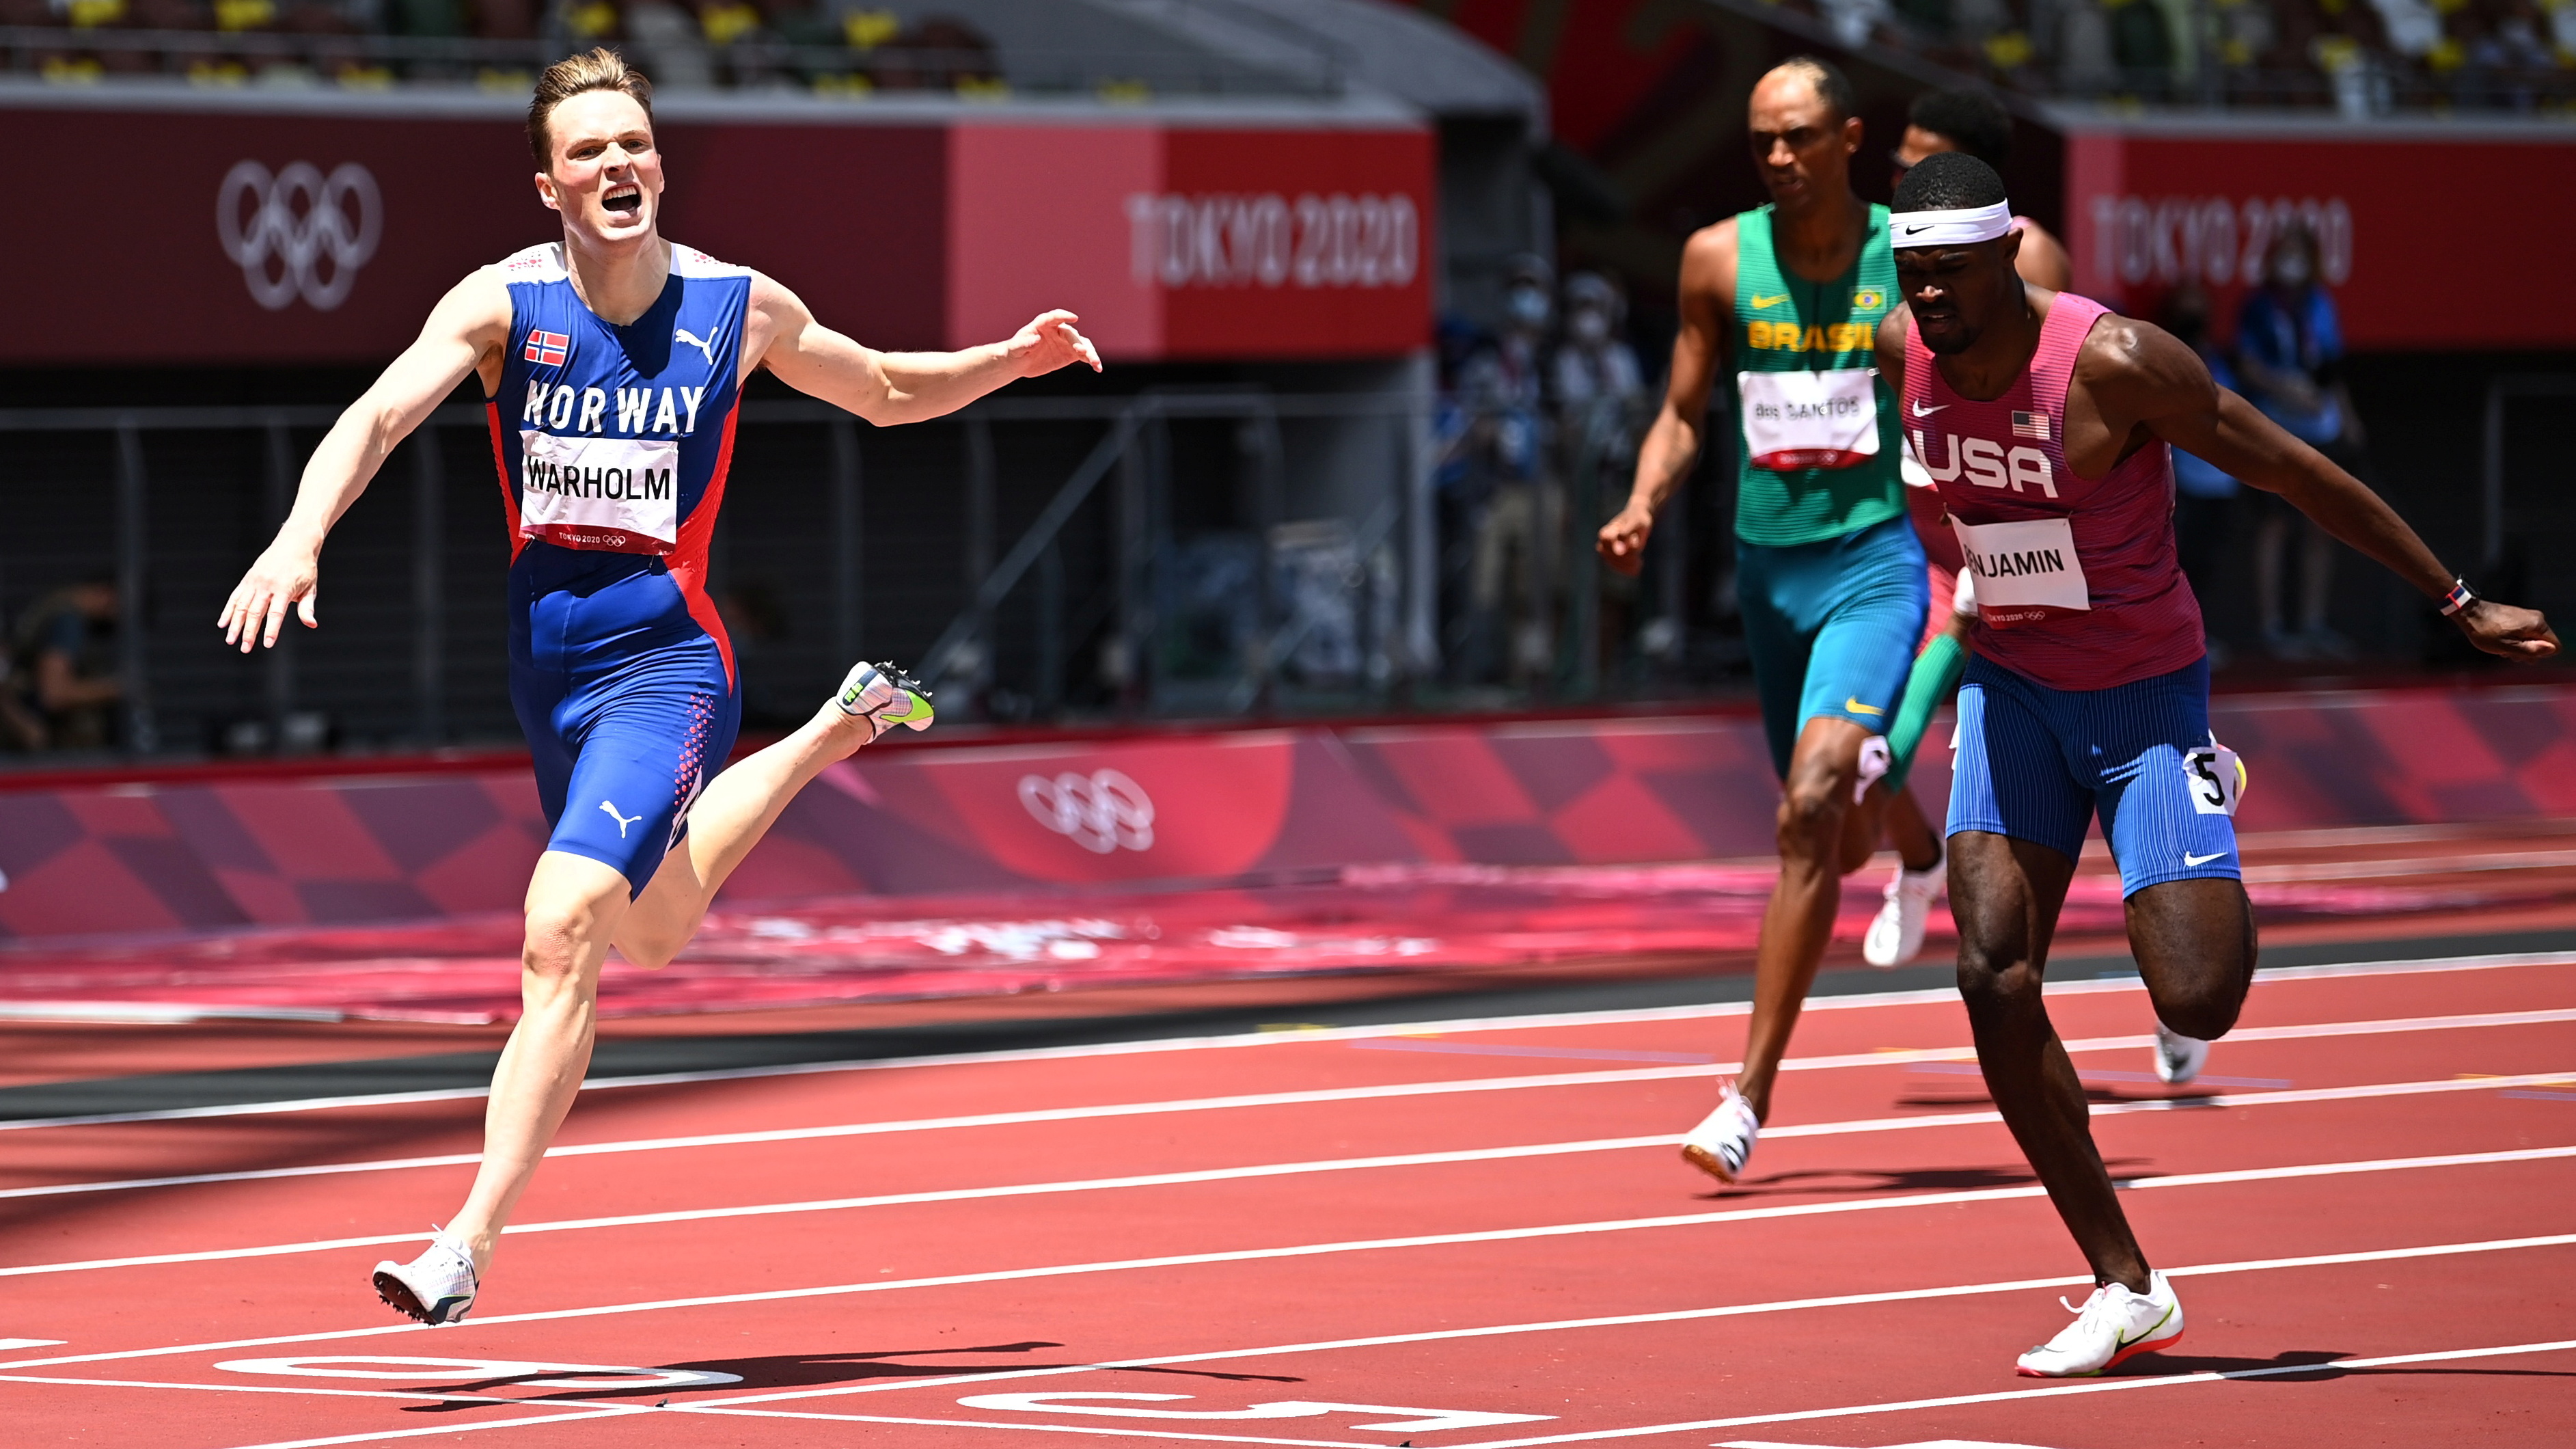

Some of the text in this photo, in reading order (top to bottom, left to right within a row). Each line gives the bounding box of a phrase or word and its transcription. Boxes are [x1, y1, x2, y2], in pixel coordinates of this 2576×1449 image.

[1125, 192, 1418, 287] TOKYO 2020
[2092, 196, 2236, 284] TOKYO
[523, 379, 704, 433] NORWAY
[1755, 396, 1859, 420] dos SANTOS
[527, 455, 670, 500] WARHOLM
[1913, 430, 2059, 498] USA
[558, 532, 600, 543] TOKYO 2020
[1987, 613, 2023, 622] KYO 2020
[2193, 753, 2225, 807] 5
[957, 1392, 1561, 1433] 5
